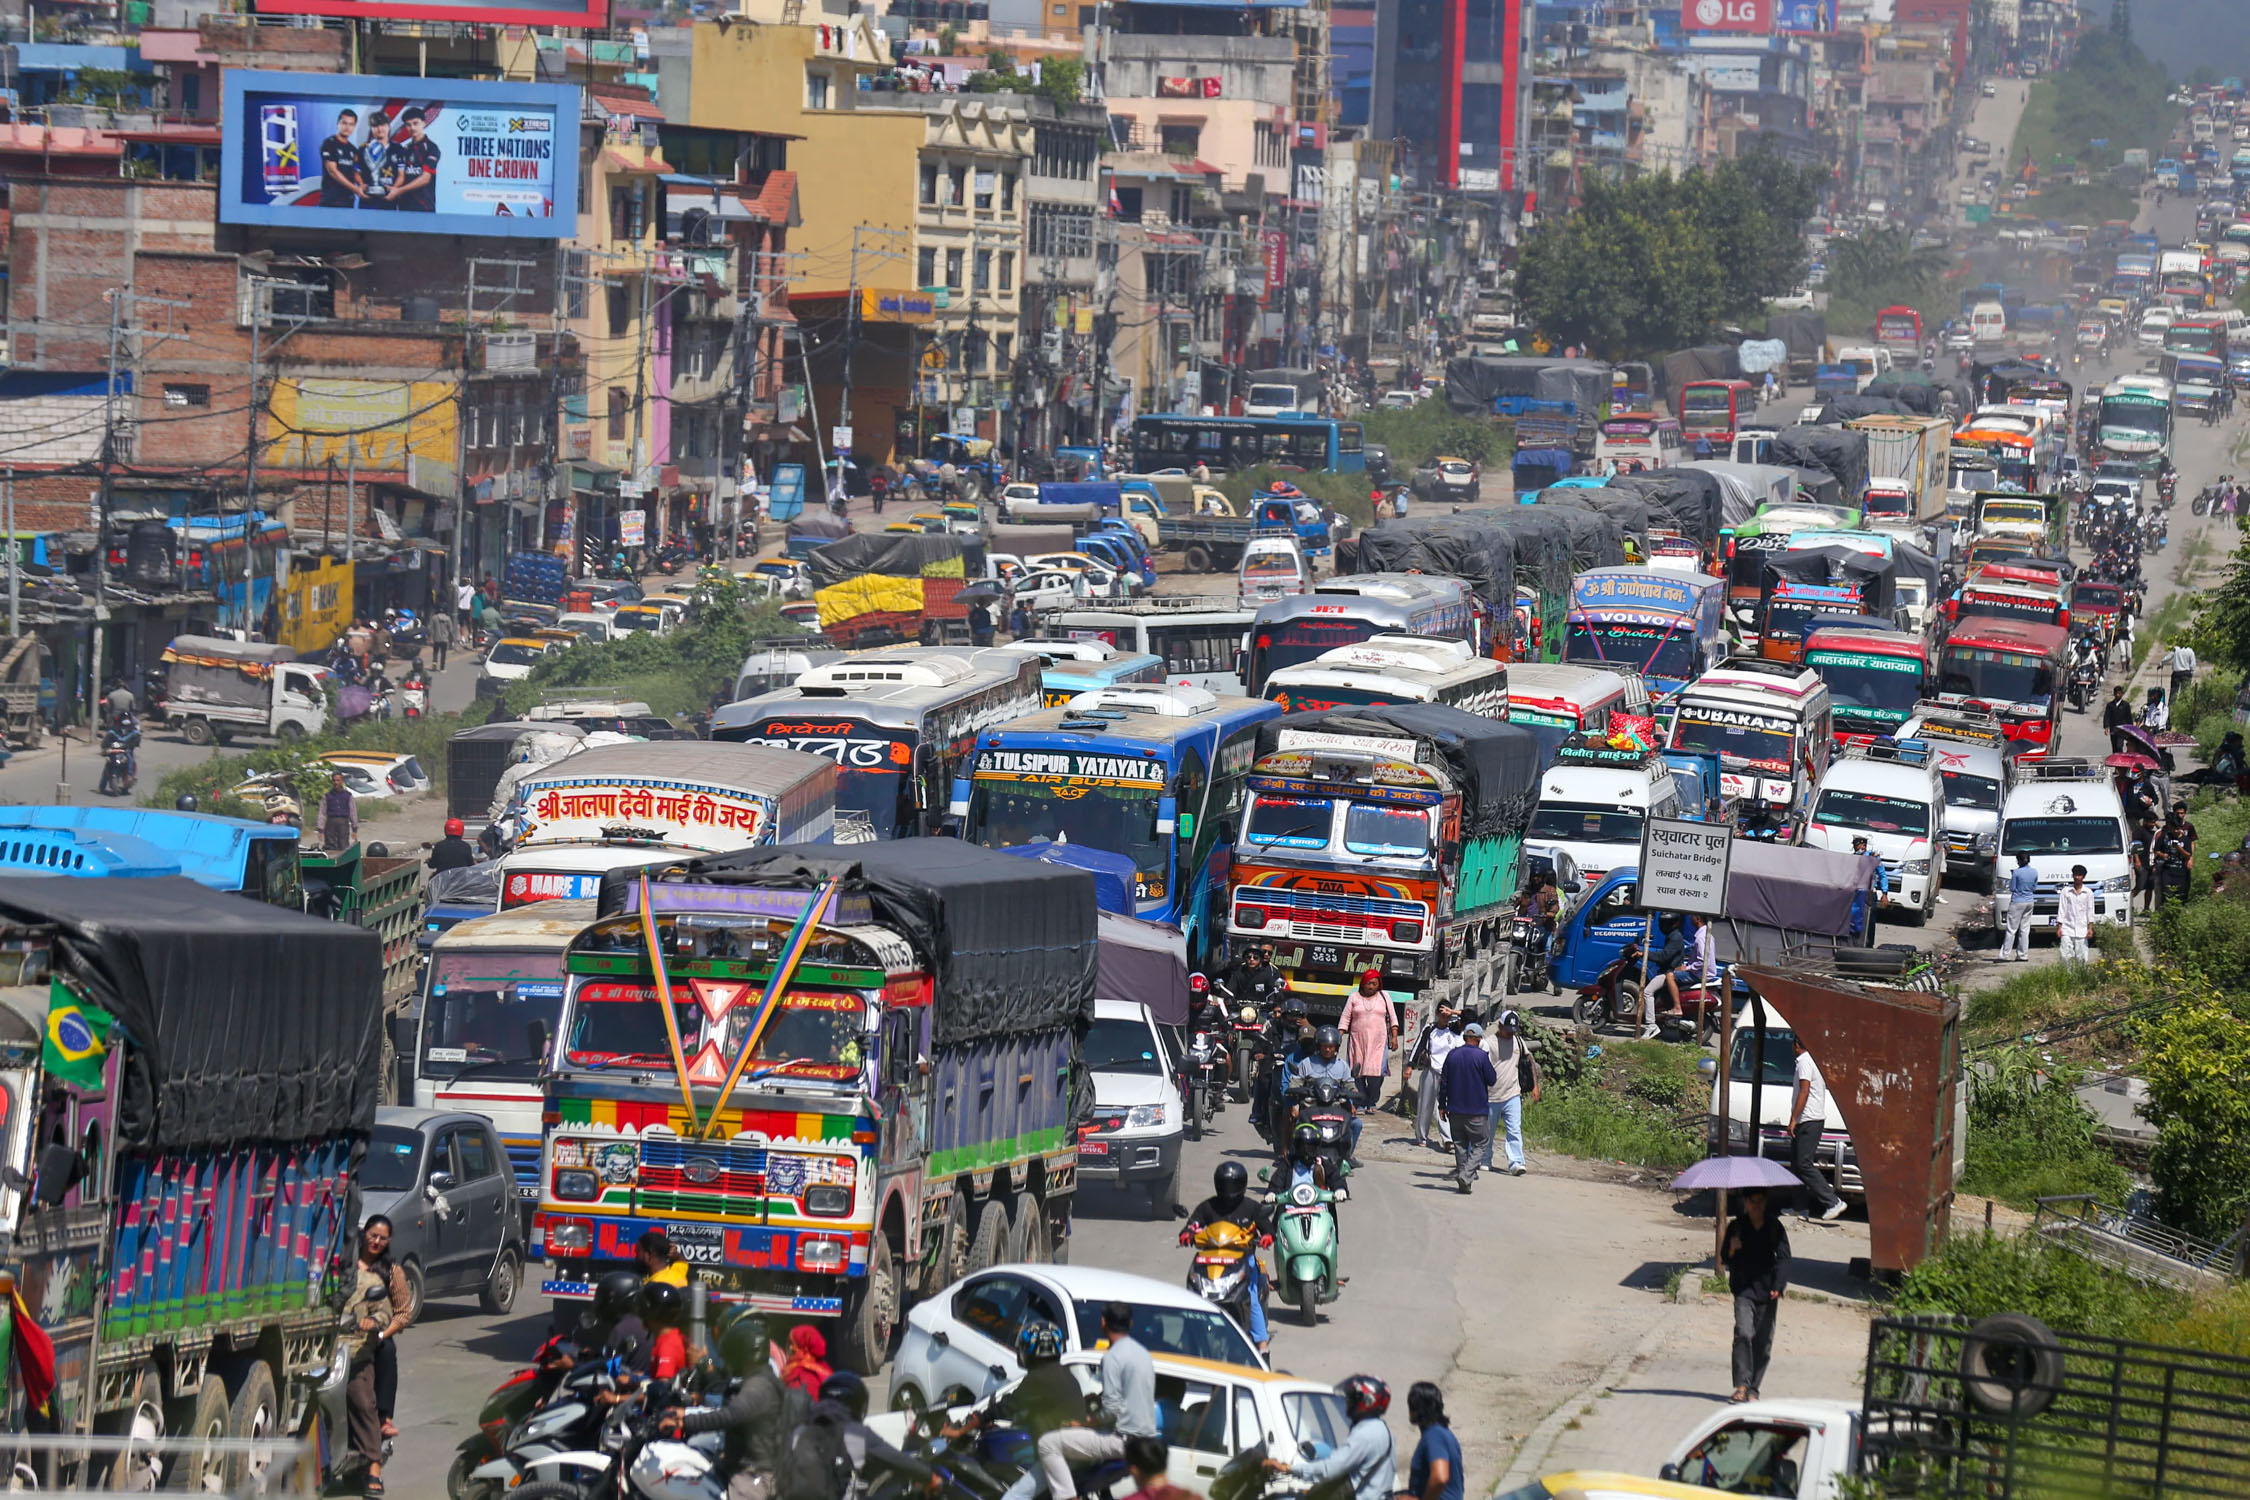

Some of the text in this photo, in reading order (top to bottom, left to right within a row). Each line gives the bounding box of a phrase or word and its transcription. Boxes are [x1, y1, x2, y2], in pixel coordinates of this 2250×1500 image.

[1726, 2, 1756, 21] LG
[457, 136, 550, 159] THREE NATIONS
[468, 158, 539, 179] ONE CROWN
[1600, 580, 1616, 597] श्री
[1617, 580, 1663, 599] गणेशाय
[1309, 605, 1349, 614] JET
[1974, 599, 2056, 614] METRO DELUXE
[1976, 592, 2057, 609] GODAWARI
[1600, 612, 1667, 625] VOLVO
[993, 752, 1149, 779] TULSIPUR YATAYAT
[1020, 774, 1118, 788] AIR BUS
[537, 788, 758, 833] श्री जालपा देवी माई की जय
[1651, 828, 1727, 851] स्युचाटार पुल
[1651, 849, 1722, 866] Suichatar Bridge
[1655, 869, 1681, 880] लम्बाई
[530, 875, 601, 899] HARE RA
[1316, 881, 1345, 893] TATA
[675, 1243, 722, 1263] ७८८
